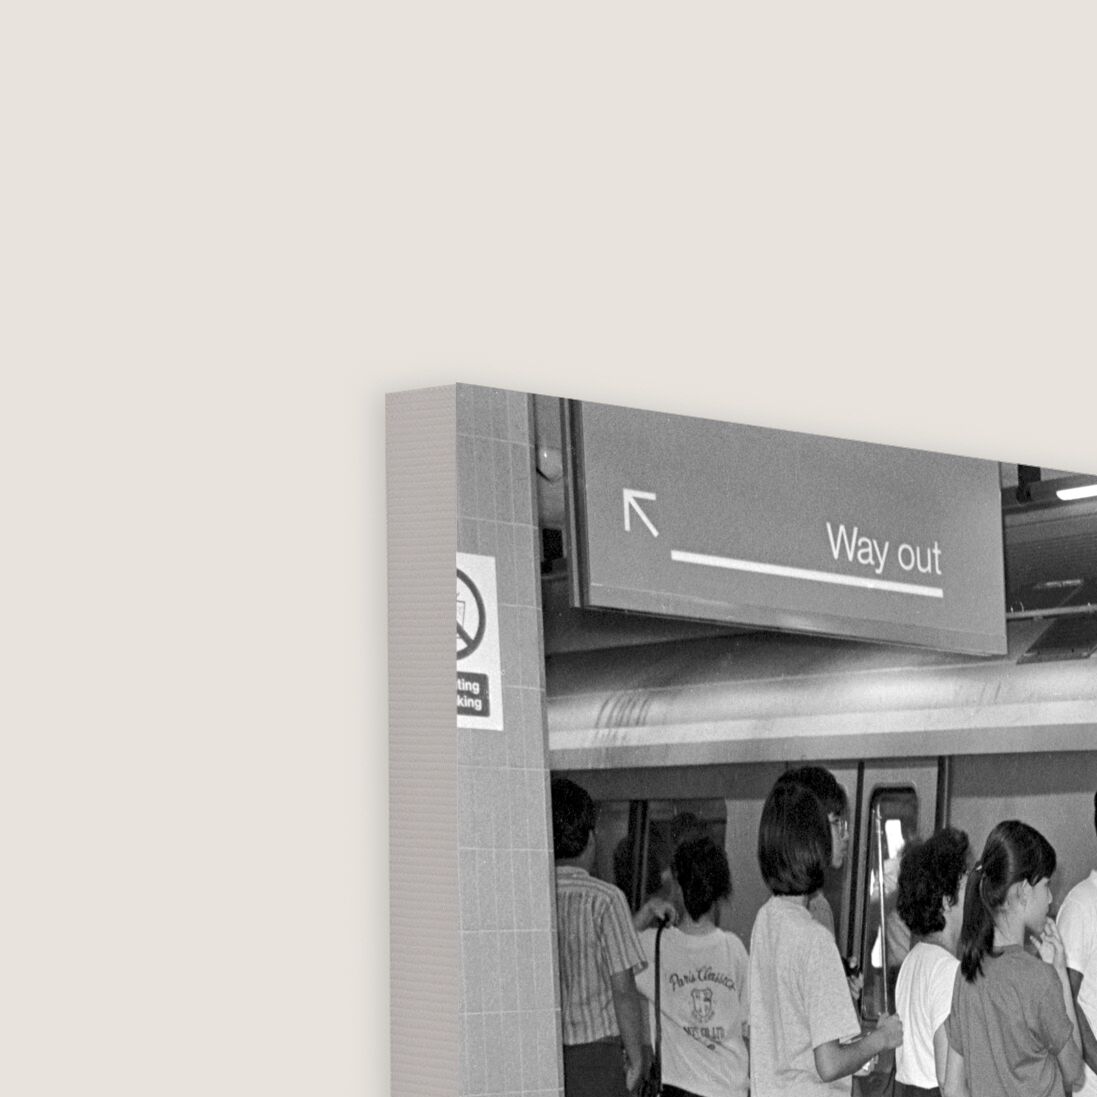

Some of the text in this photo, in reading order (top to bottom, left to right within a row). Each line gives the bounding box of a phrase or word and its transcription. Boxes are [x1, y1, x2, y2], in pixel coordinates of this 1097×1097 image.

[826, 521, 942, 576] Way out
[457, 677, 481, 694] ting
[457, 695, 483, 712] king
[669, 970, 696, 993] Paris
